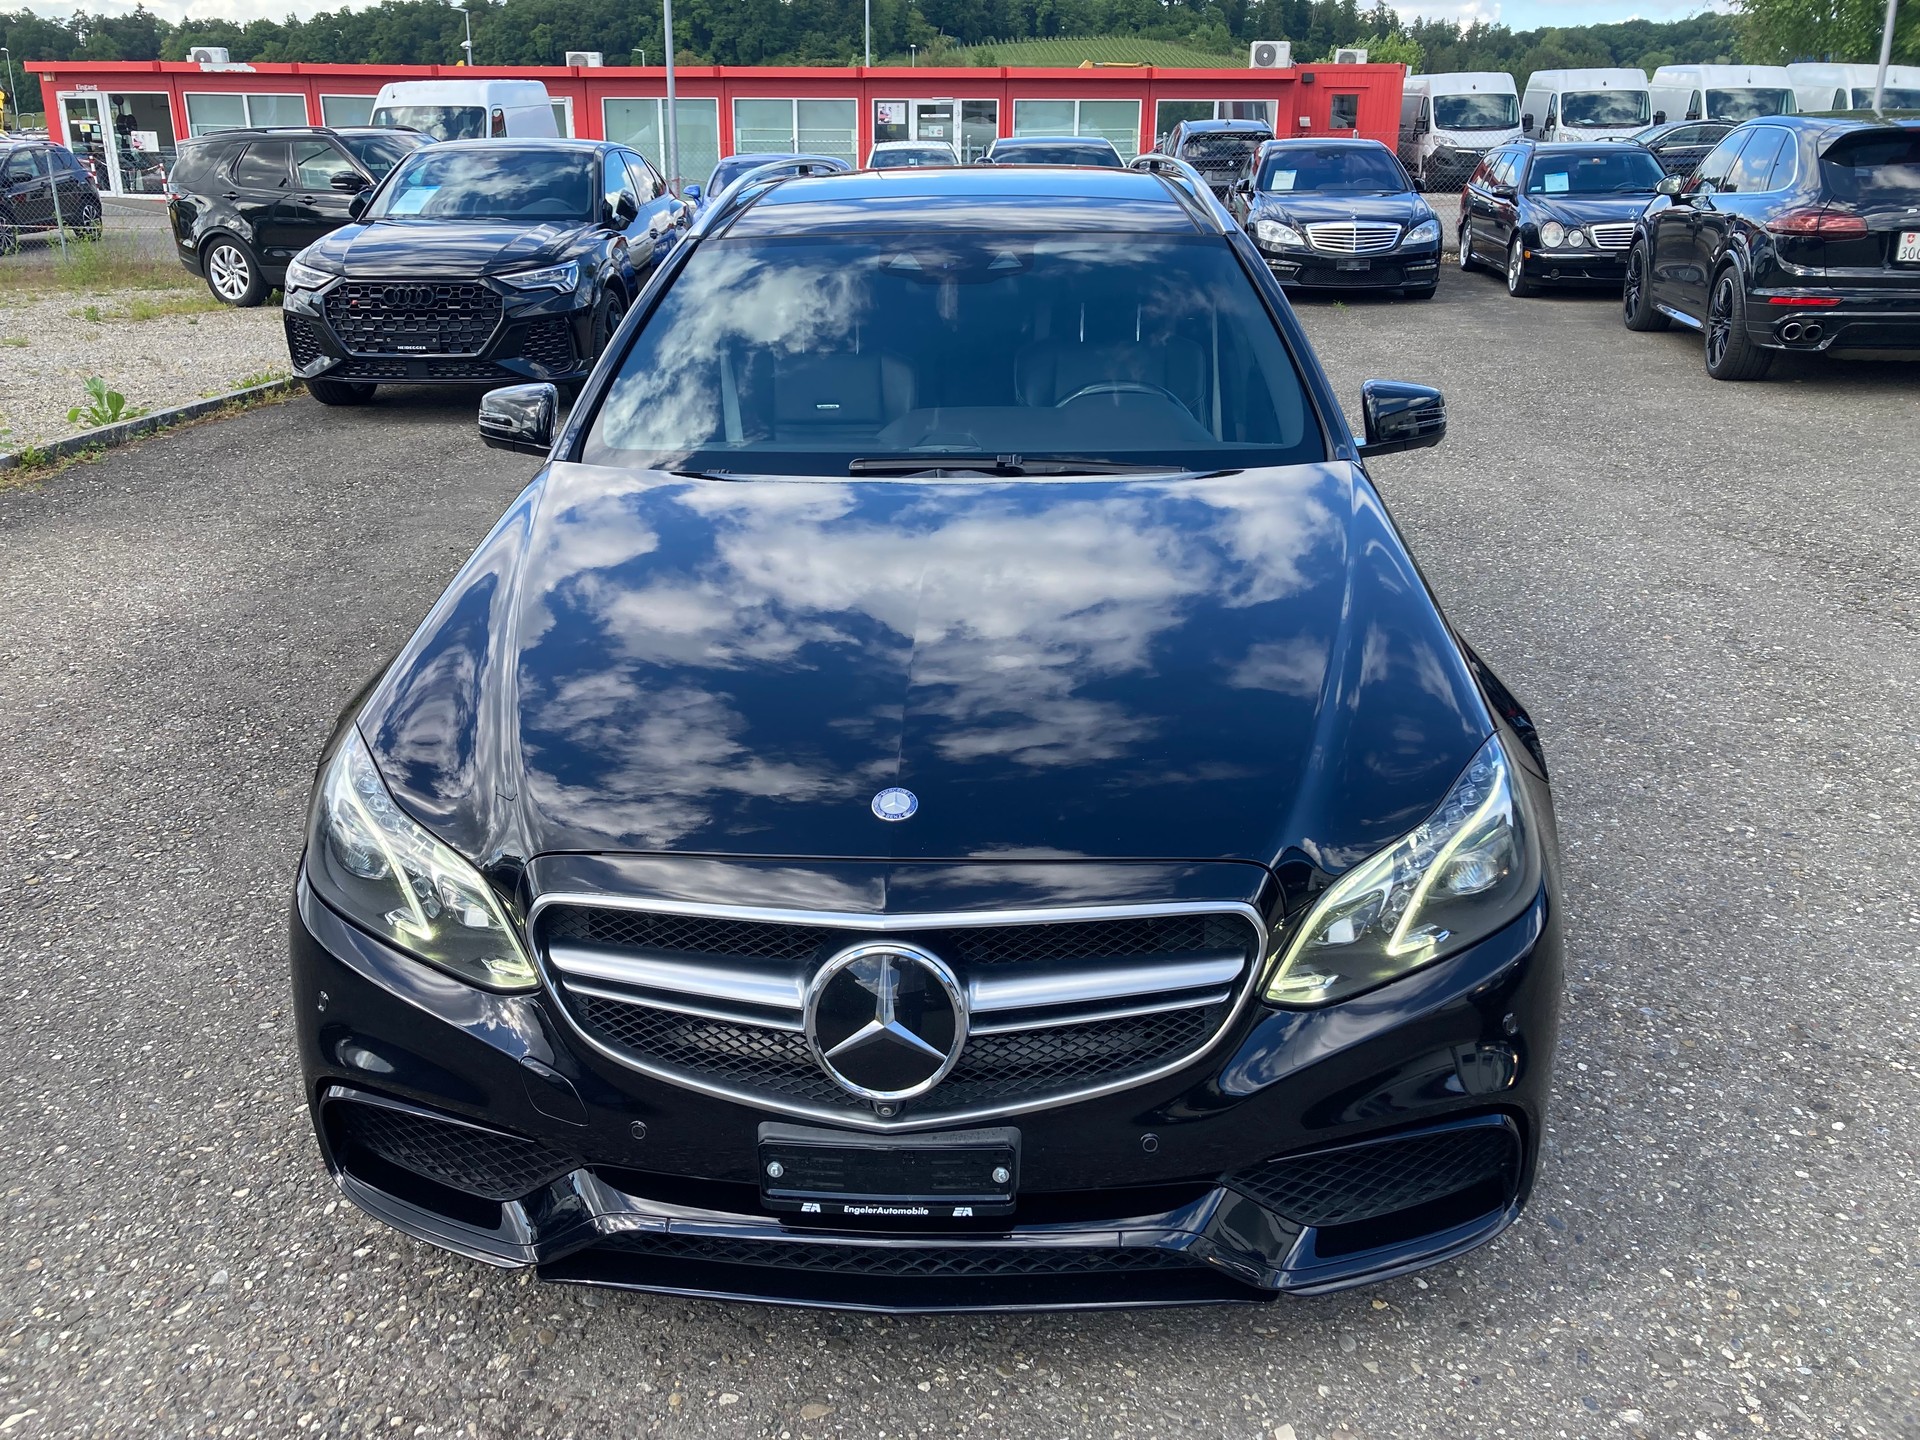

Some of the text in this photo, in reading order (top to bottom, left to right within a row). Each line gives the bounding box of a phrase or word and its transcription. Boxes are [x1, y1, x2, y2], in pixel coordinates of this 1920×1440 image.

[801, 1202, 973, 1217] EA EngelerAutomobile EA
